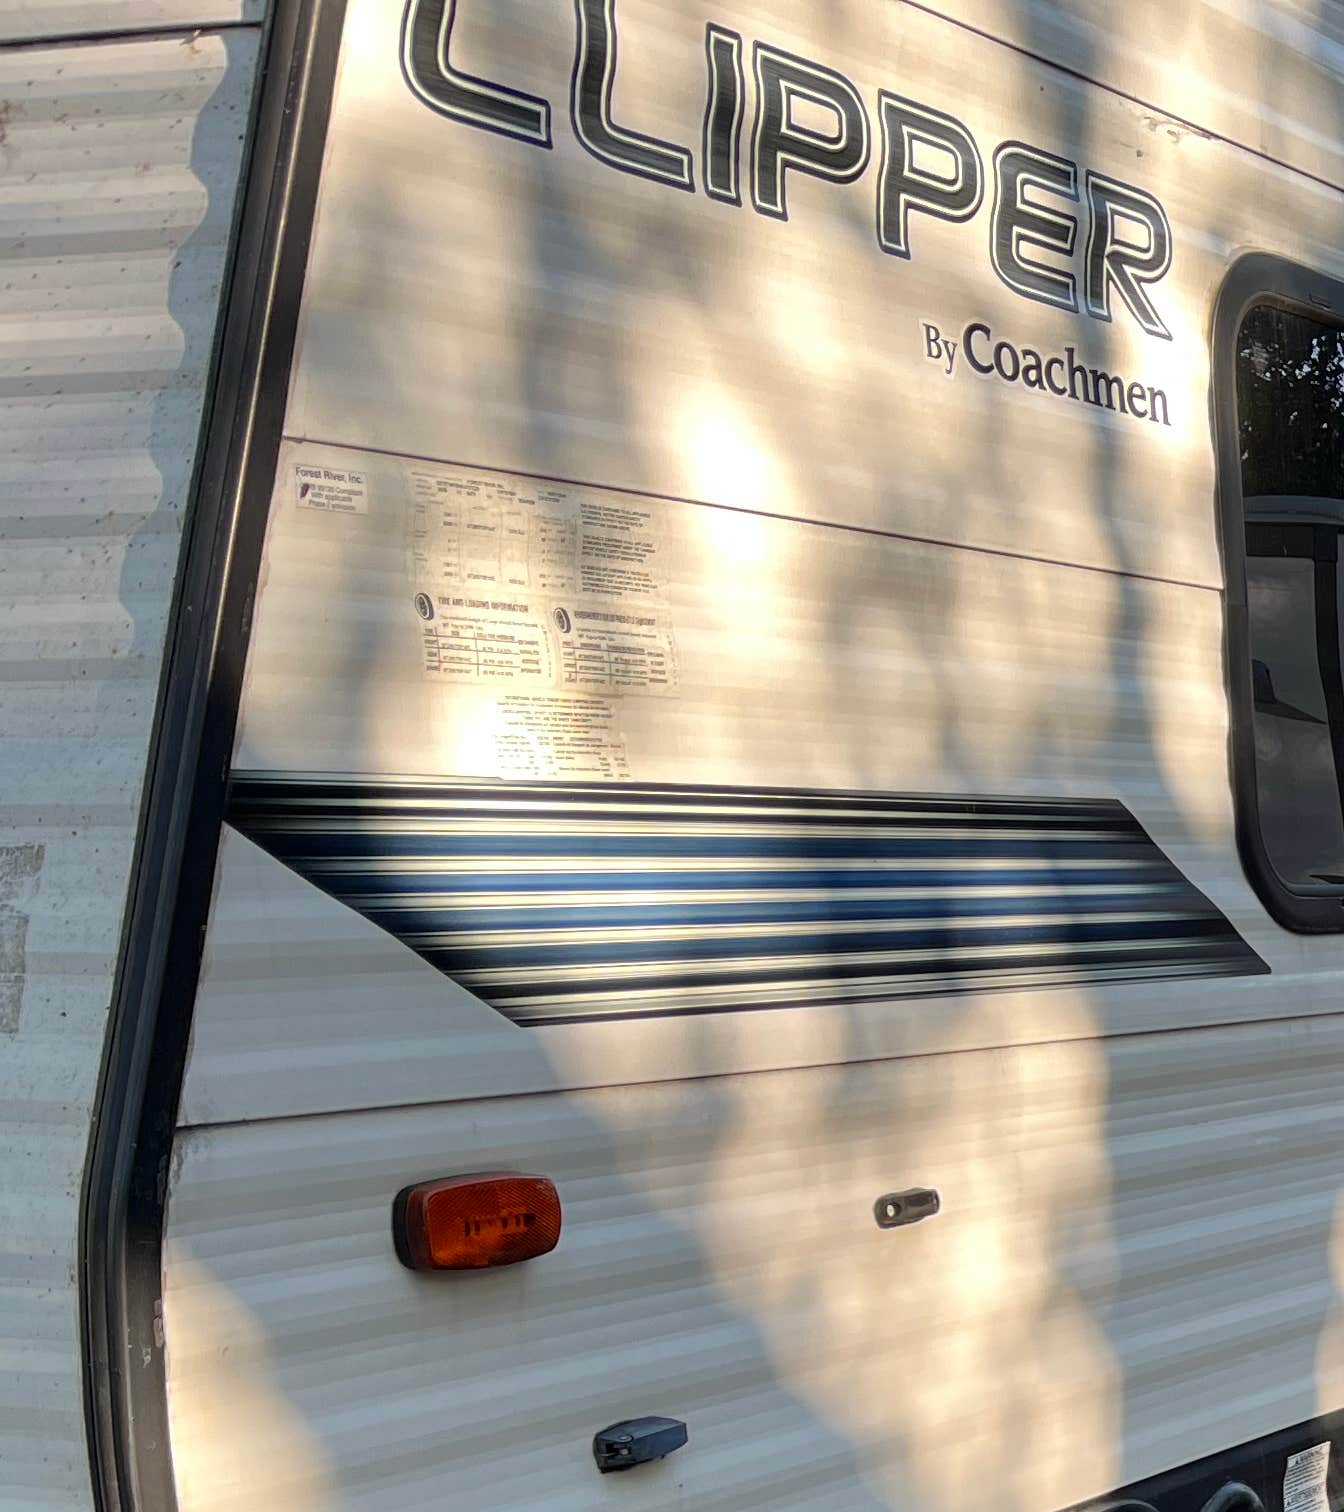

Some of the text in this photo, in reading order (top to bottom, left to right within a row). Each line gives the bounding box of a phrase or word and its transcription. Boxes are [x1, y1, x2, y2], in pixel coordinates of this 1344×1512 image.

[399, 0, 1172, 340] CLIPPER
[923, 322, 1172, 427] By Coachmen
